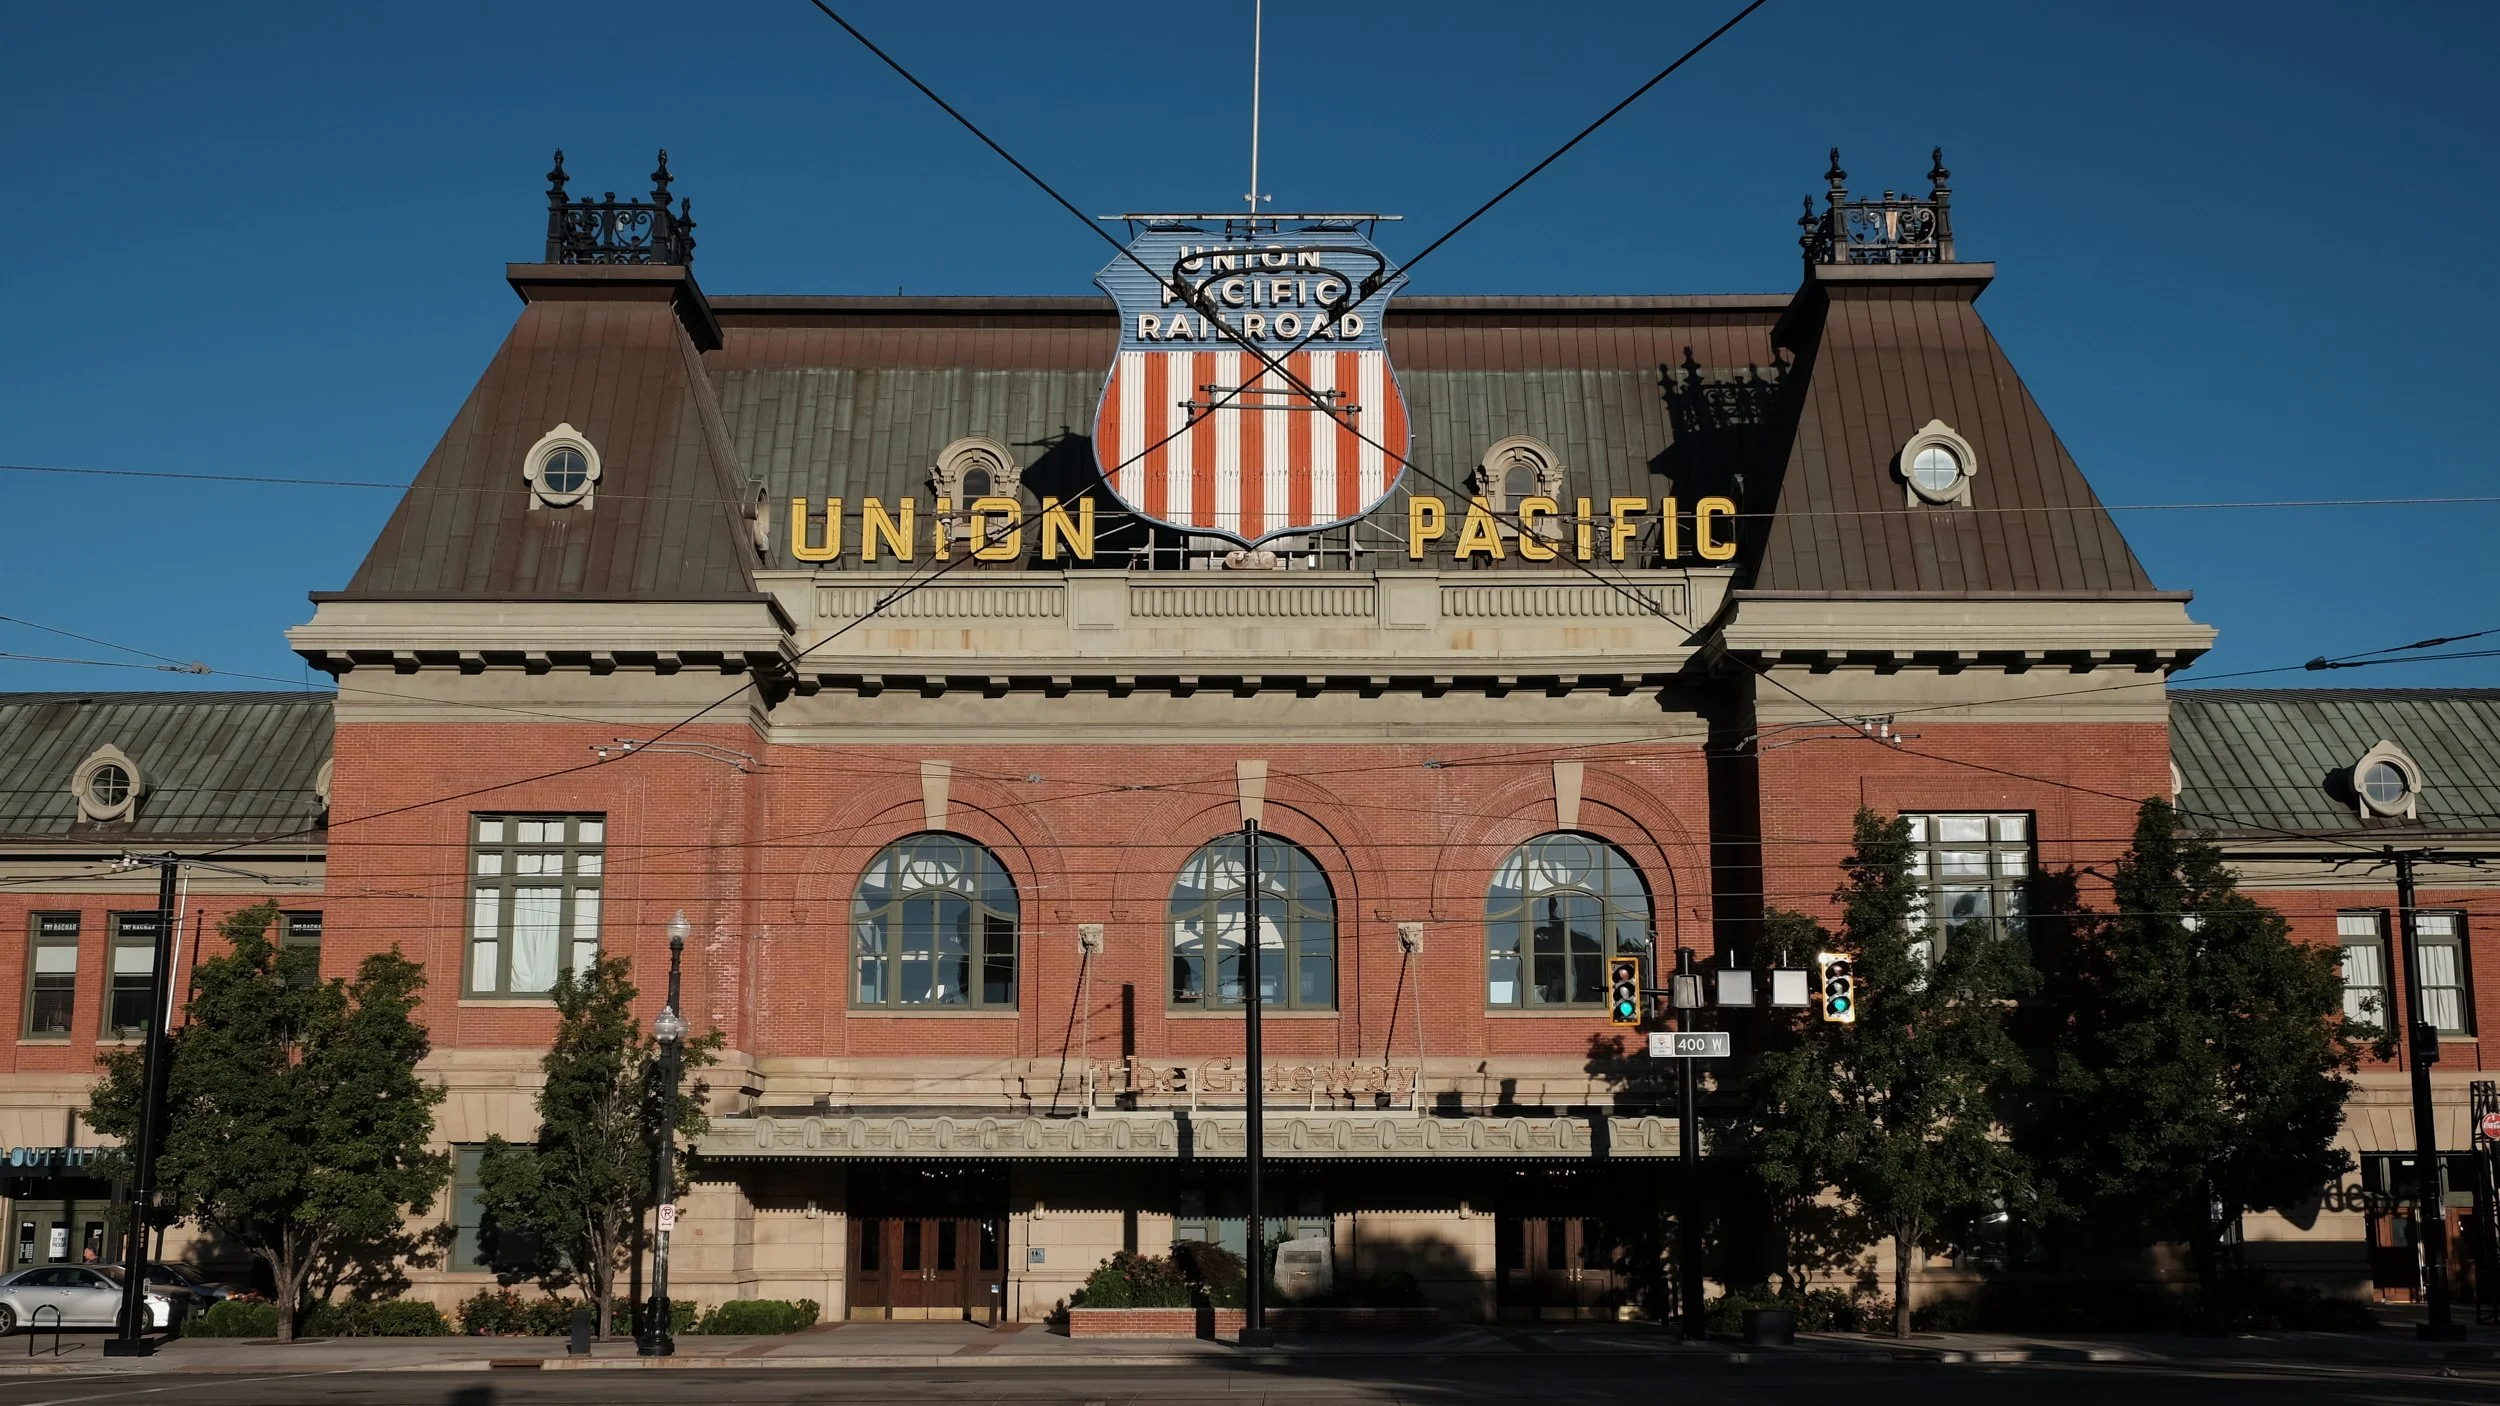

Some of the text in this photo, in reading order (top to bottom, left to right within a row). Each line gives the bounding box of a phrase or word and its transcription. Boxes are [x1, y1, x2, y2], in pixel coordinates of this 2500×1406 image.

[1180, 245, 1320, 271] UNION
[1161, 278, 1339, 306] PACIFIC
[1138, 312, 1364, 340] RAILROAD
[790, 495, 1738, 562] UNION PACIFIC
[1677, 1038, 1705, 1051] 400
[1712, 1038, 1722, 1051] W
[1090, 1055, 1419, 1102] The Gteway
